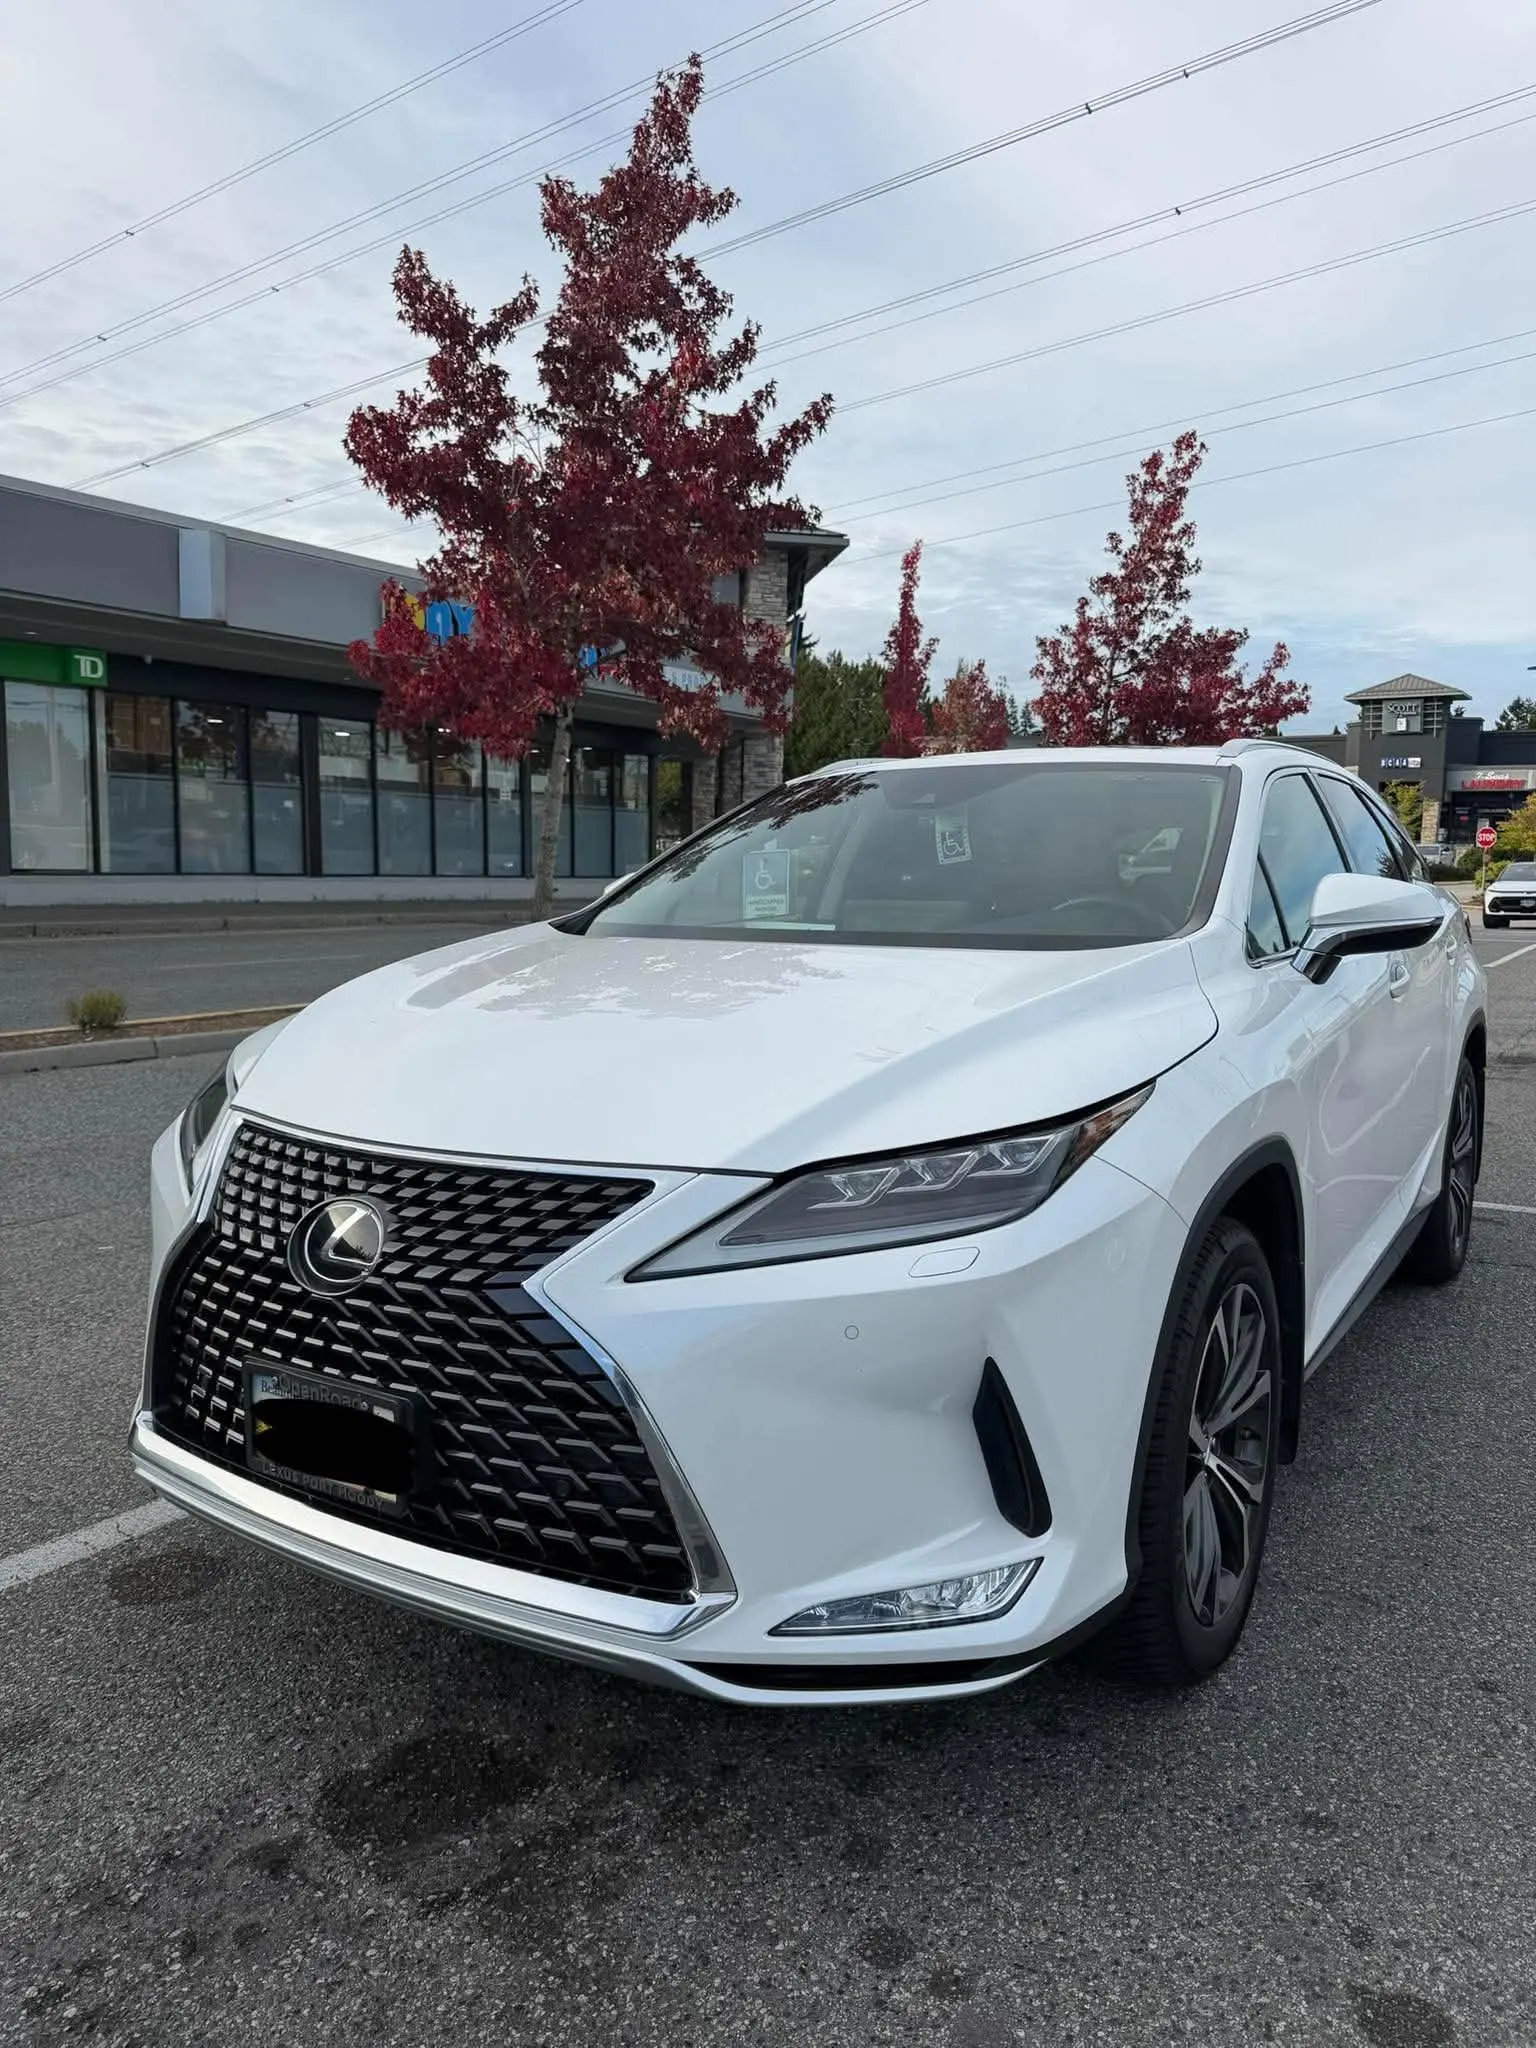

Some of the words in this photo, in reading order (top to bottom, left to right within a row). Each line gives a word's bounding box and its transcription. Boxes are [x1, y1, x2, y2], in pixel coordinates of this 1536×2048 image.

[73, 654, 104, 679] TD
[1386, 702, 1418, 713] SCOTT
[1478, 834, 1496, 844] STOP
[262, 1463, 299, 1483] LEXUS
[302, 1475, 335, 1497] PORT
[339, 1486, 384, 1511] MOODY
